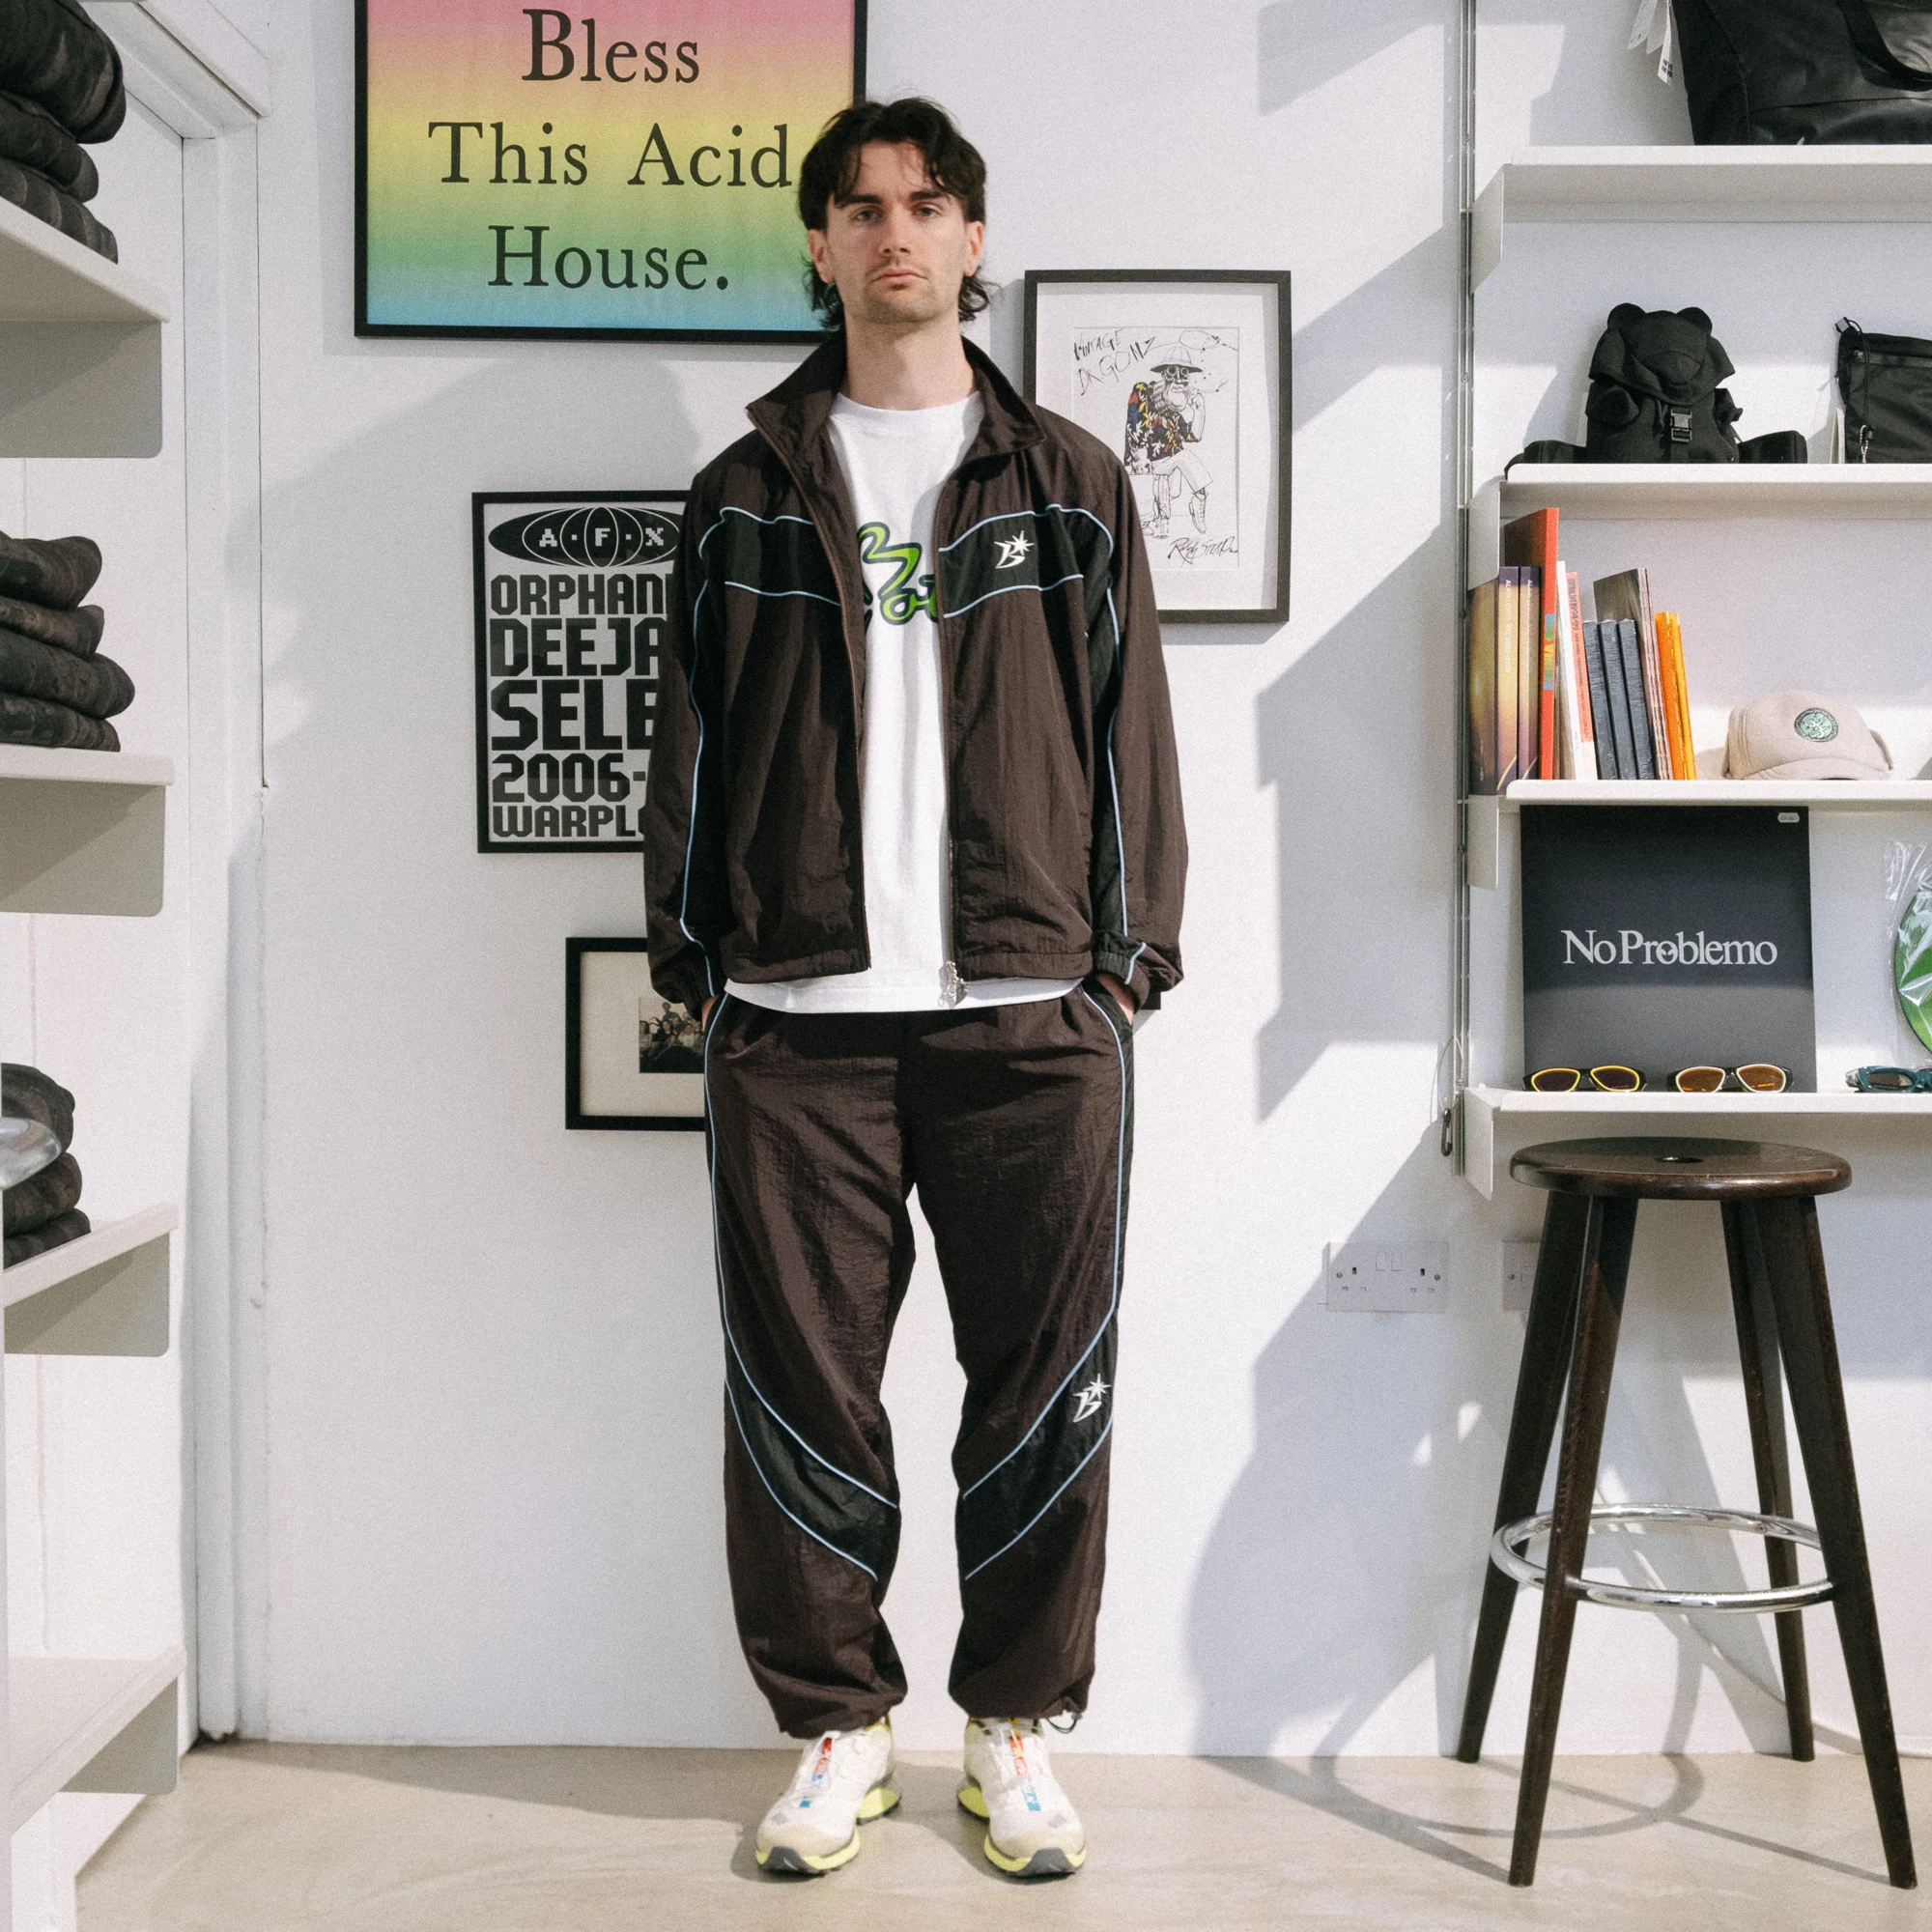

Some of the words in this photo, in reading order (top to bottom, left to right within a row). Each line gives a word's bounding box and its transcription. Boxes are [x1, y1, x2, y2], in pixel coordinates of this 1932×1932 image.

[522, 9, 699, 83] Bless
[428, 122, 587, 185] This
[627, 123, 792, 188] Acid
[488, 225, 728, 291] House.
[491, 574, 672, 615] ORPHAN
[493, 805, 644, 838] WARPL
